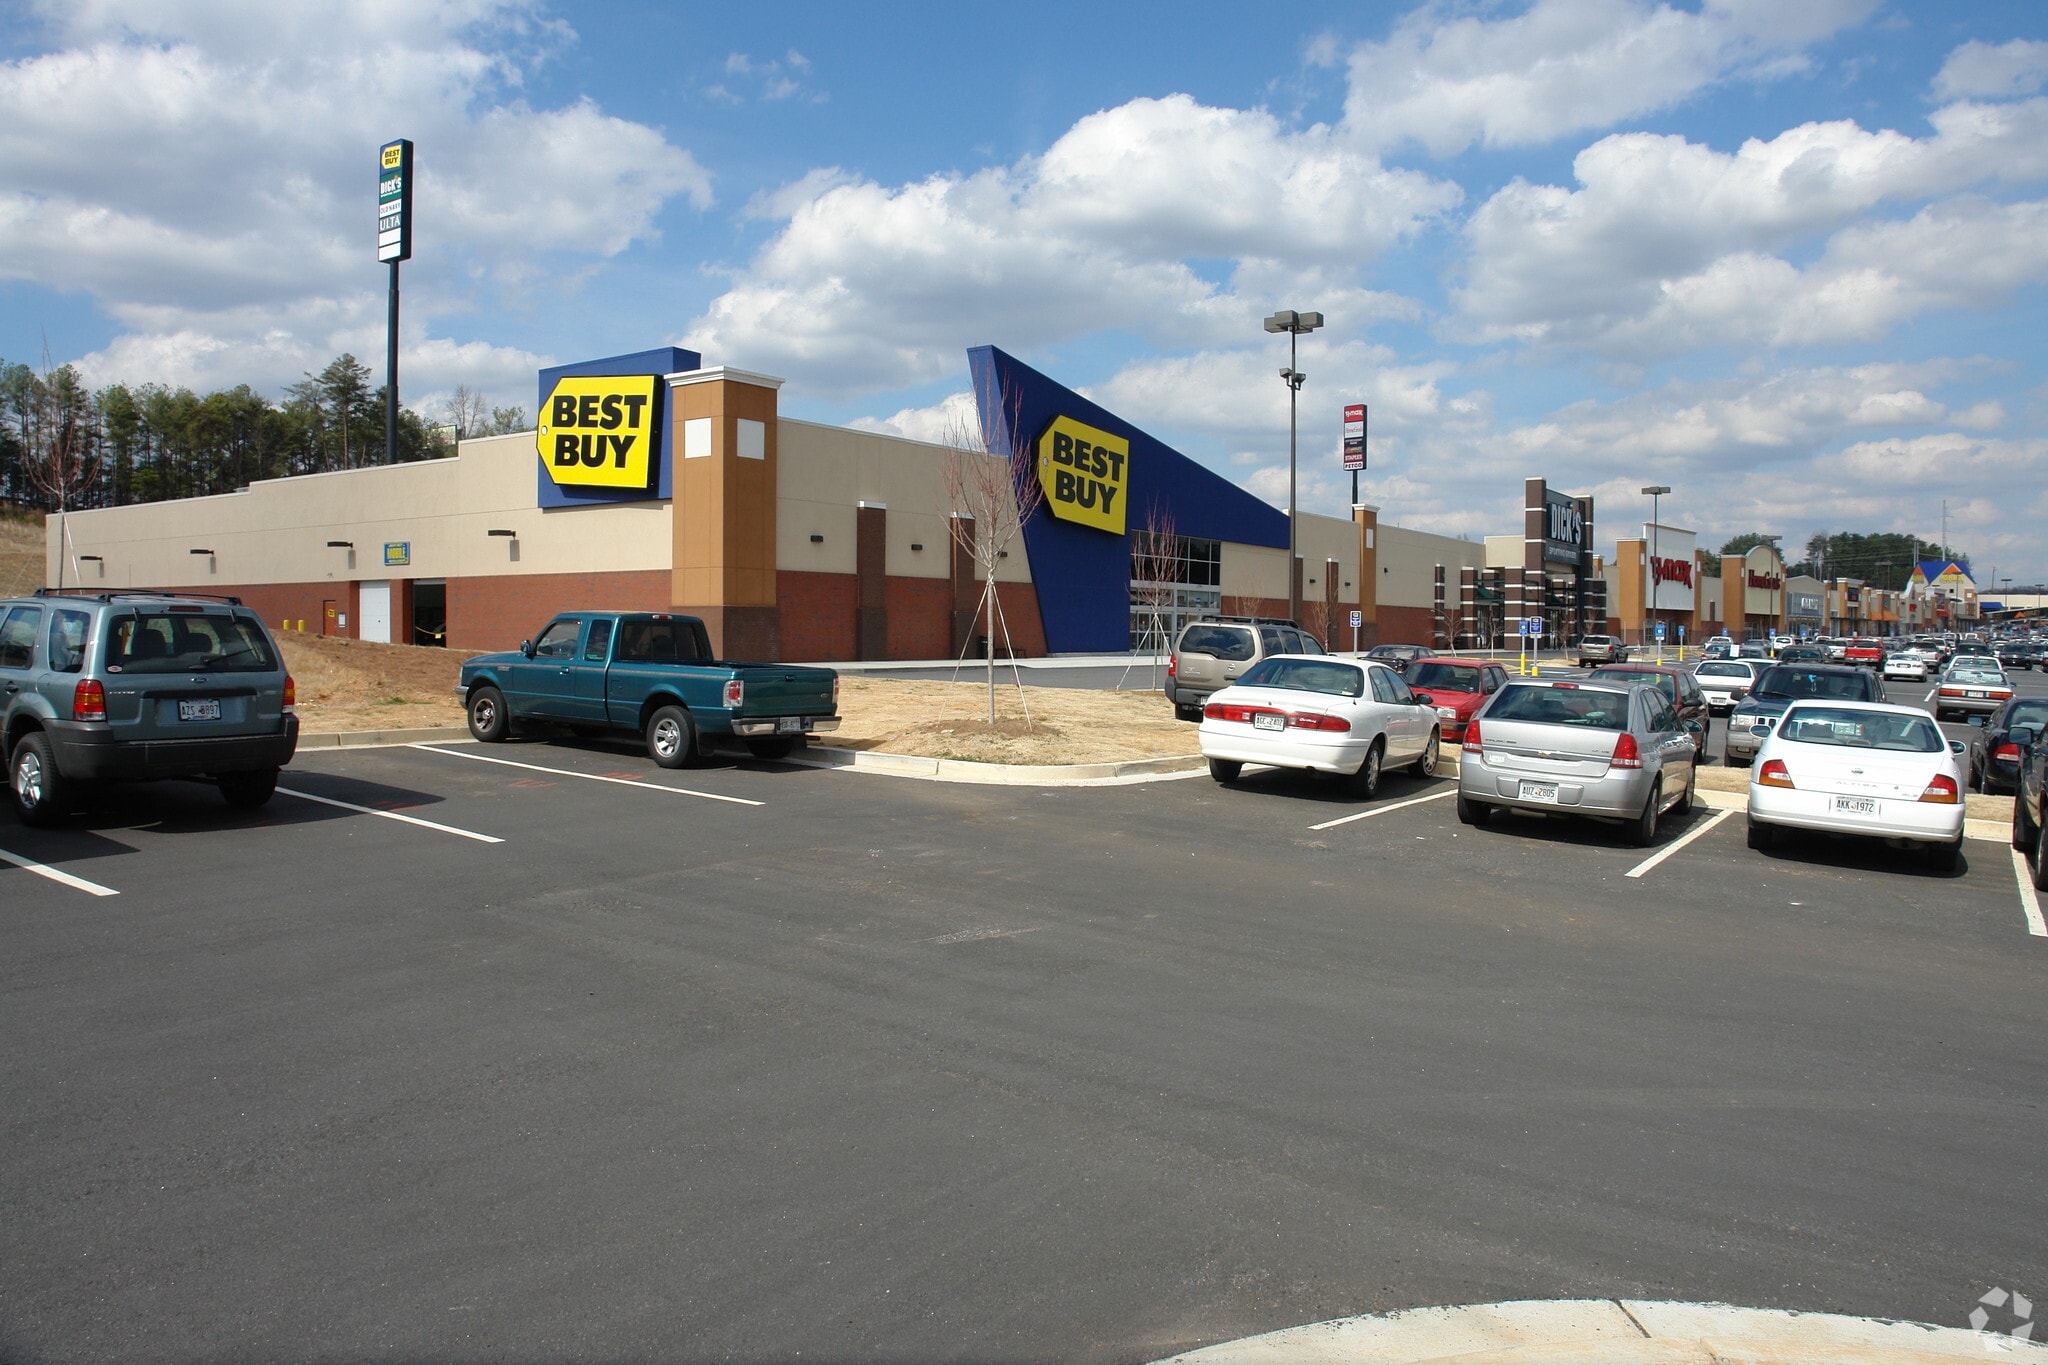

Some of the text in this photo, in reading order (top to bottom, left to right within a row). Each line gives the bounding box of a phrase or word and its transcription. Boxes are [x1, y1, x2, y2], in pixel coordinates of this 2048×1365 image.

[384, 149, 400, 158] BEST
[384, 157, 398, 165] BUY
[380, 176, 402, 195] DICK'S
[380, 214, 401, 231] ULTA
[552, 394, 648, 430] BEST
[554, 434, 637, 468] BUY
[1053, 431, 1124, 482] BEST
[1055, 469, 1118, 515] BUY
[1551, 503, 1582, 545] DICK'S
[1522, 786, 1555, 798] AUZ 2805
[1836, 800, 1874, 813] AKK 1972
